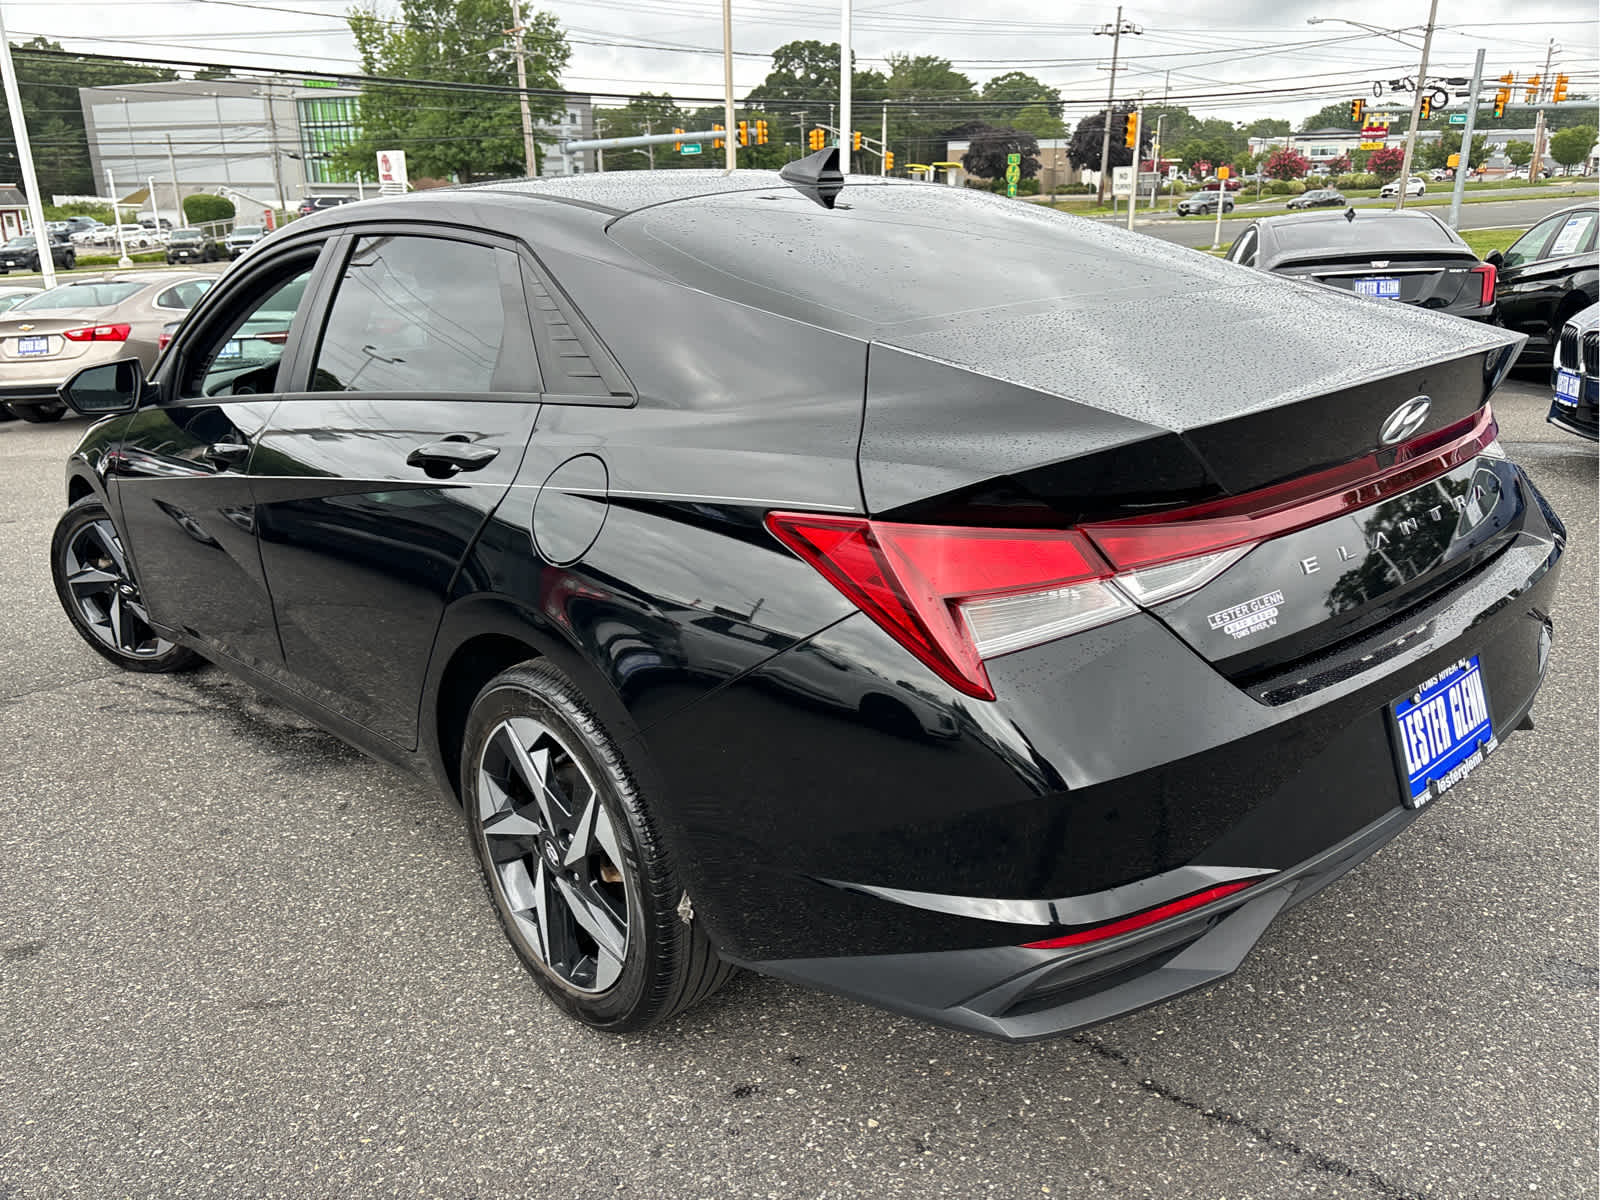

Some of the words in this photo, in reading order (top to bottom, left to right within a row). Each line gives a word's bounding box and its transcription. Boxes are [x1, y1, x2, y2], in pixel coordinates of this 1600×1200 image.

[1298, 485, 1487, 575] ELANTRA
[1208, 604, 1250, 628] LESTER
[1250, 591, 1285, 611] GLENN
[1418, 674, 1439, 694] TOMS
[1398, 695, 1452, 775] LESTER
[1449, 668, 1488, 741] GLENN
